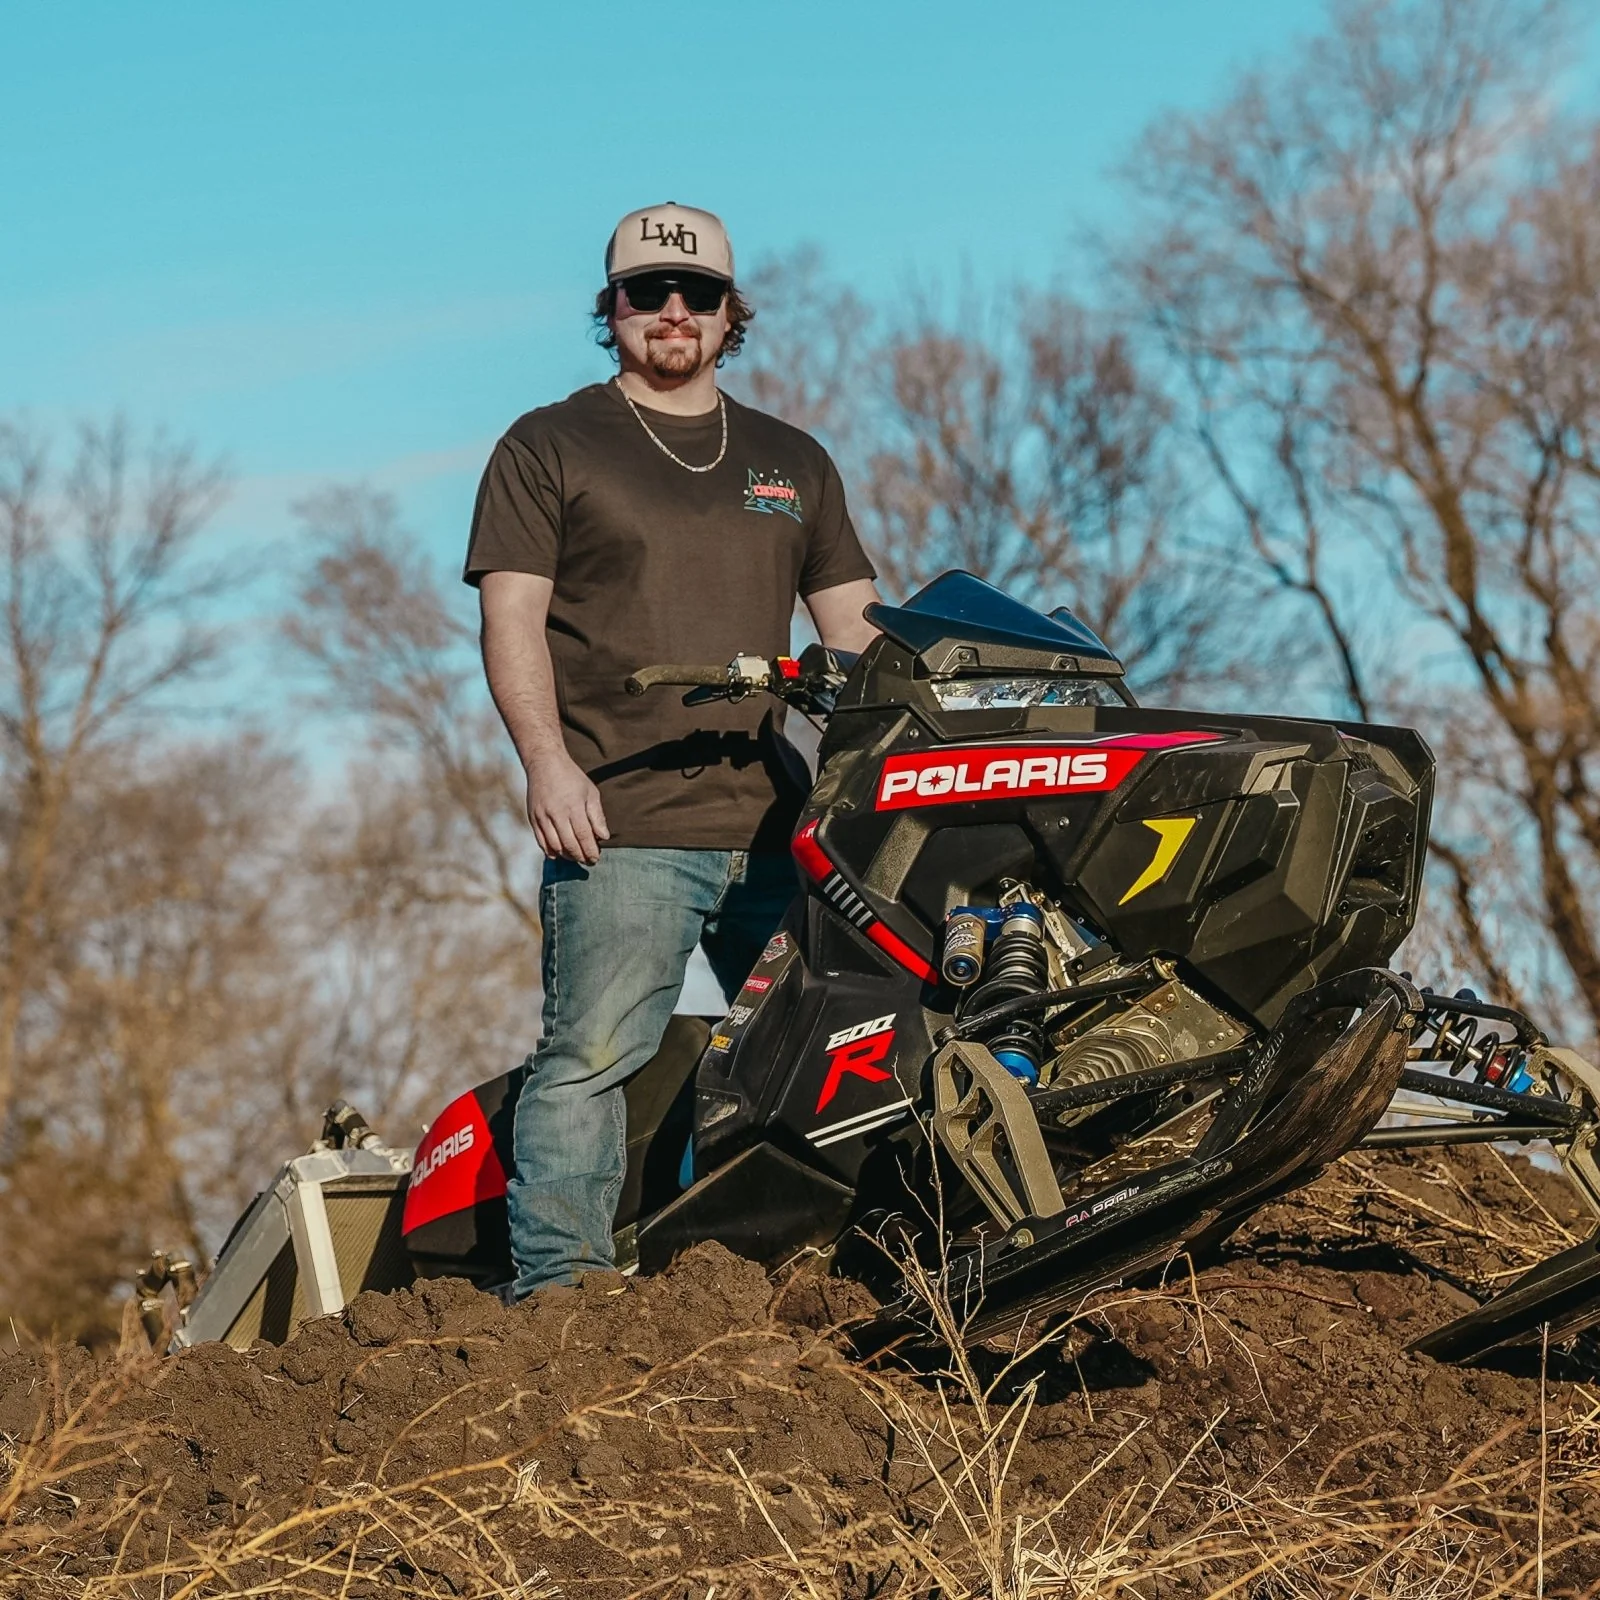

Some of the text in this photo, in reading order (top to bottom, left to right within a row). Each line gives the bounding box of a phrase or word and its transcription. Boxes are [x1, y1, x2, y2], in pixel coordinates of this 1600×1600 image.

[880, 753, 1108, 802] POLARIS
[824, 1012, 897, 1052] 600
[815, 1029, 897, 1116] R
